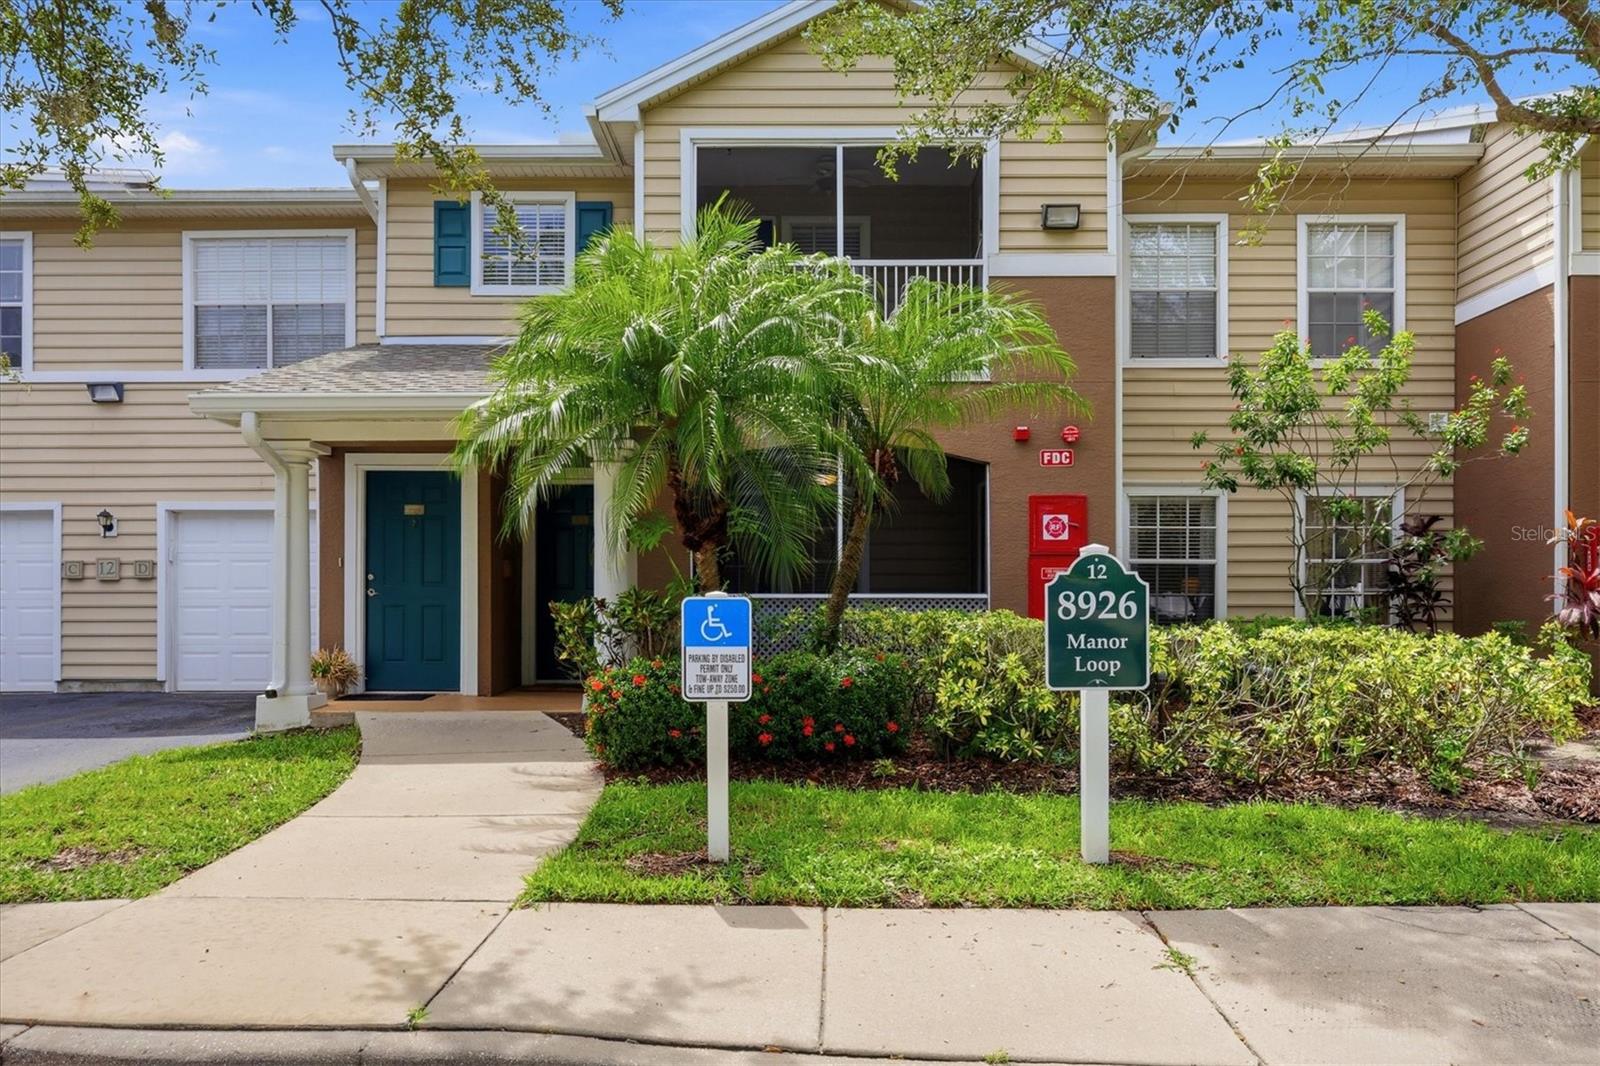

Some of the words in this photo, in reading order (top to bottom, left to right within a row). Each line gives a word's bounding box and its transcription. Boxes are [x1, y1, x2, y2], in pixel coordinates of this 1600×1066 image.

[1043, 452, 1070, 464] FDC
[100, 561, 116, 575] 12
[1087, 564, 1107, 579] 12
[1057, 590, 1138, 620] 8926
[1066, 633, 1128, 649] Manor
[688, 654, 710, 663] PARKING
[711, 654, 719, 663] BY
[720, 654, 746, 663] DISABLED
[700, 664, 719, 673] PERMIT
[720, 664, 733, 673] ONLY
[1074, 656, 1121, 677] Loop
[695, 674, 723, 683] TOW-AWAY
[724, 674, 738, 683] ZONE
[693, 684, 706, 693] FINE
[706, 684, 714, 693] UP
[715, 684, 722, 693] TO
